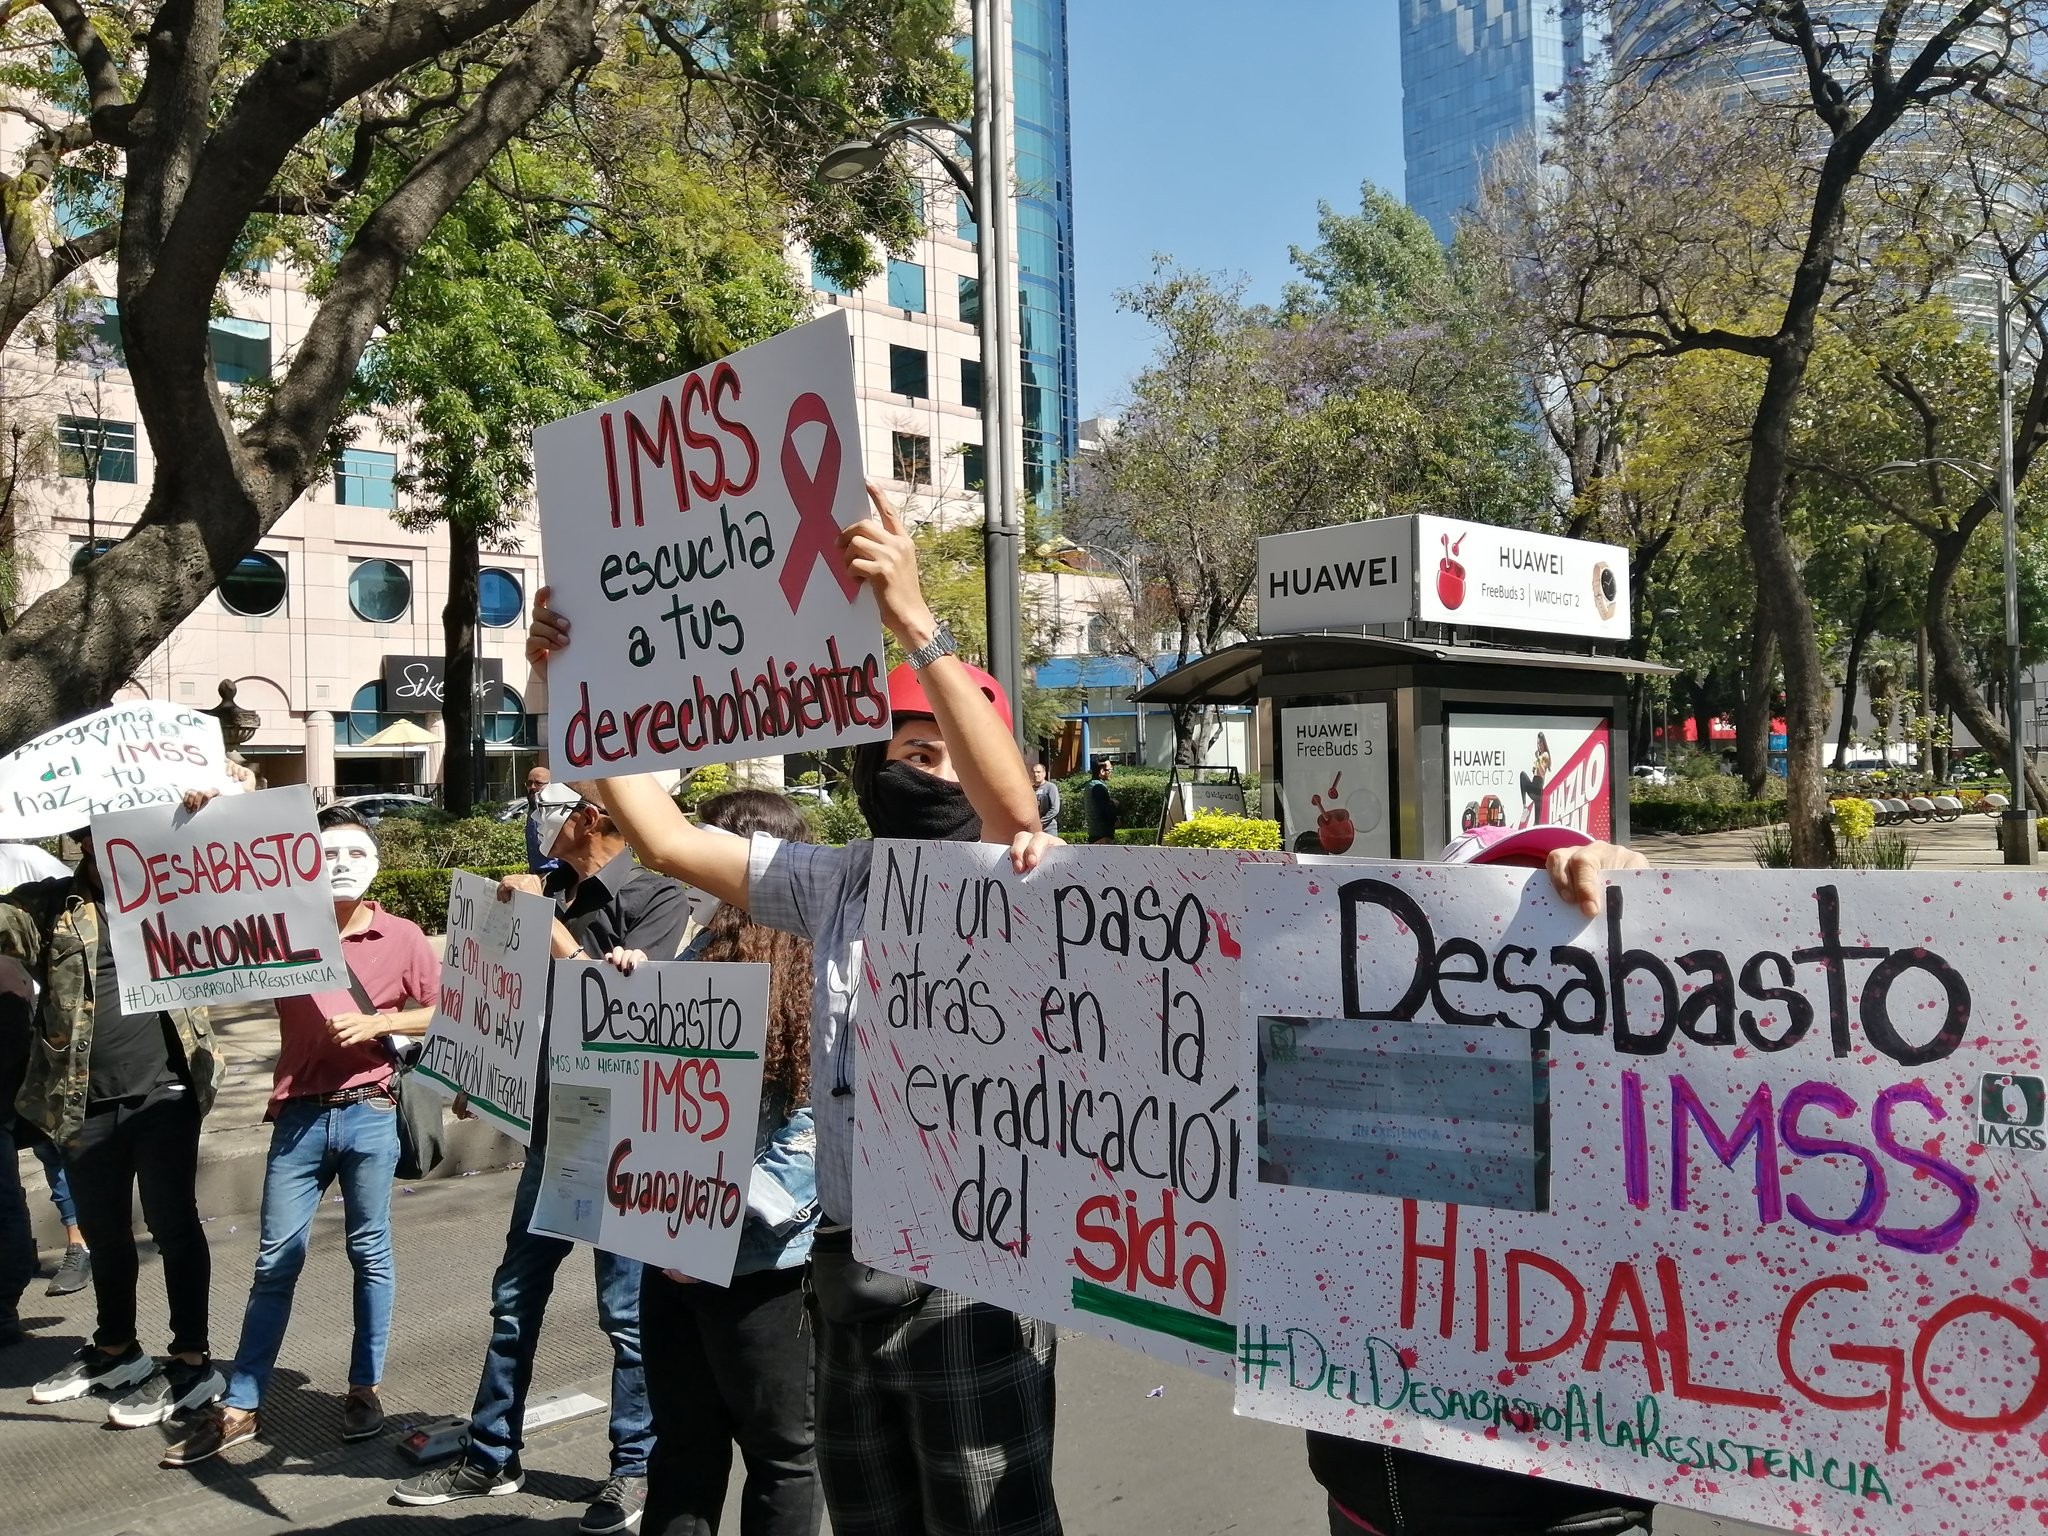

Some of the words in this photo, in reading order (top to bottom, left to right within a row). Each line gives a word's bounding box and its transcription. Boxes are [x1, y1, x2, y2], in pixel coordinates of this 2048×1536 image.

[600, 361, 760, 529] IMSS
[600, 503, 775, 601] escucha
[1269, 555, 1398, 599] HUAWEI
[1500, 546, 1564, 575] HUAWEI
[628, 626, 656, 668] a
[660, 593, 745, 660] tus
[1481, 583, 1518, 601] FreeBuds
[1519, 588, 1525, 601] 3
[1534, 589, 1562, 605] WATCH
[1563, 593, 1573, 606] GT
[1575, 595, 1580, 608] 2
[14, 706, 154, 760] programa
[90, 721, 155, 746] VIH
[565, 635, 889, 768] derechohabientes
[1296, 723, 1358, 738] HUAWEI
[40, 756, 82, 781] del
[117, 741, 208, 766] IMSS
[1297, 740, 1358, 757] FreeBuds
[1364, 740, 1373, 756] 3
[1453, 750, 1505, 767] HUAWEI
[1453, 769, 1490, 786] WATCH
[1492, 769, 1504, 786] GT
[1507, 769, 1514, 785] 2
[1549, 740, 1606, 823] HAZLO
[14, 784, 87, 816] haz
[102, 766, 146, 788] tu
[452, 877, 474, 931] Sin
[956, 876, 1012, 944] un
[1053, 884, 1208, 980] paso
[447, 929, 460, 969] de
[482, 960, 490, 999] y
[491, 963, 523, 1020] carga
[581, 966, 743, 1050] Desabasto
[1339, 878, 1972, 1067] Desabasto
[440, 976, 465, 1024] viral
[473, 997, 492, 1036] NO
[495, 1012, 525, 1060] HAY
[887, 942, 1006, 1046] atrás
[1040, 985, 1106, 1063] en
[1161, 967, 1206, 1085] la
[485, 1061, 532, 1121] INTEGRAL
[576, 1057, 590, 1071] NO
[641, 1057, 731, 1143] IMSS
[1620, 1069, 1980, 1255] IMSS
[1978, 1123, 2047, 1151] IMSS
[607, 1138, 742, 1239] Guanajuato
[951, 1144, 1030, 1258] del
[1073, 1188, 1227, 1316] sida
[1400, 1197, 2048, 1451] HIDALGO
